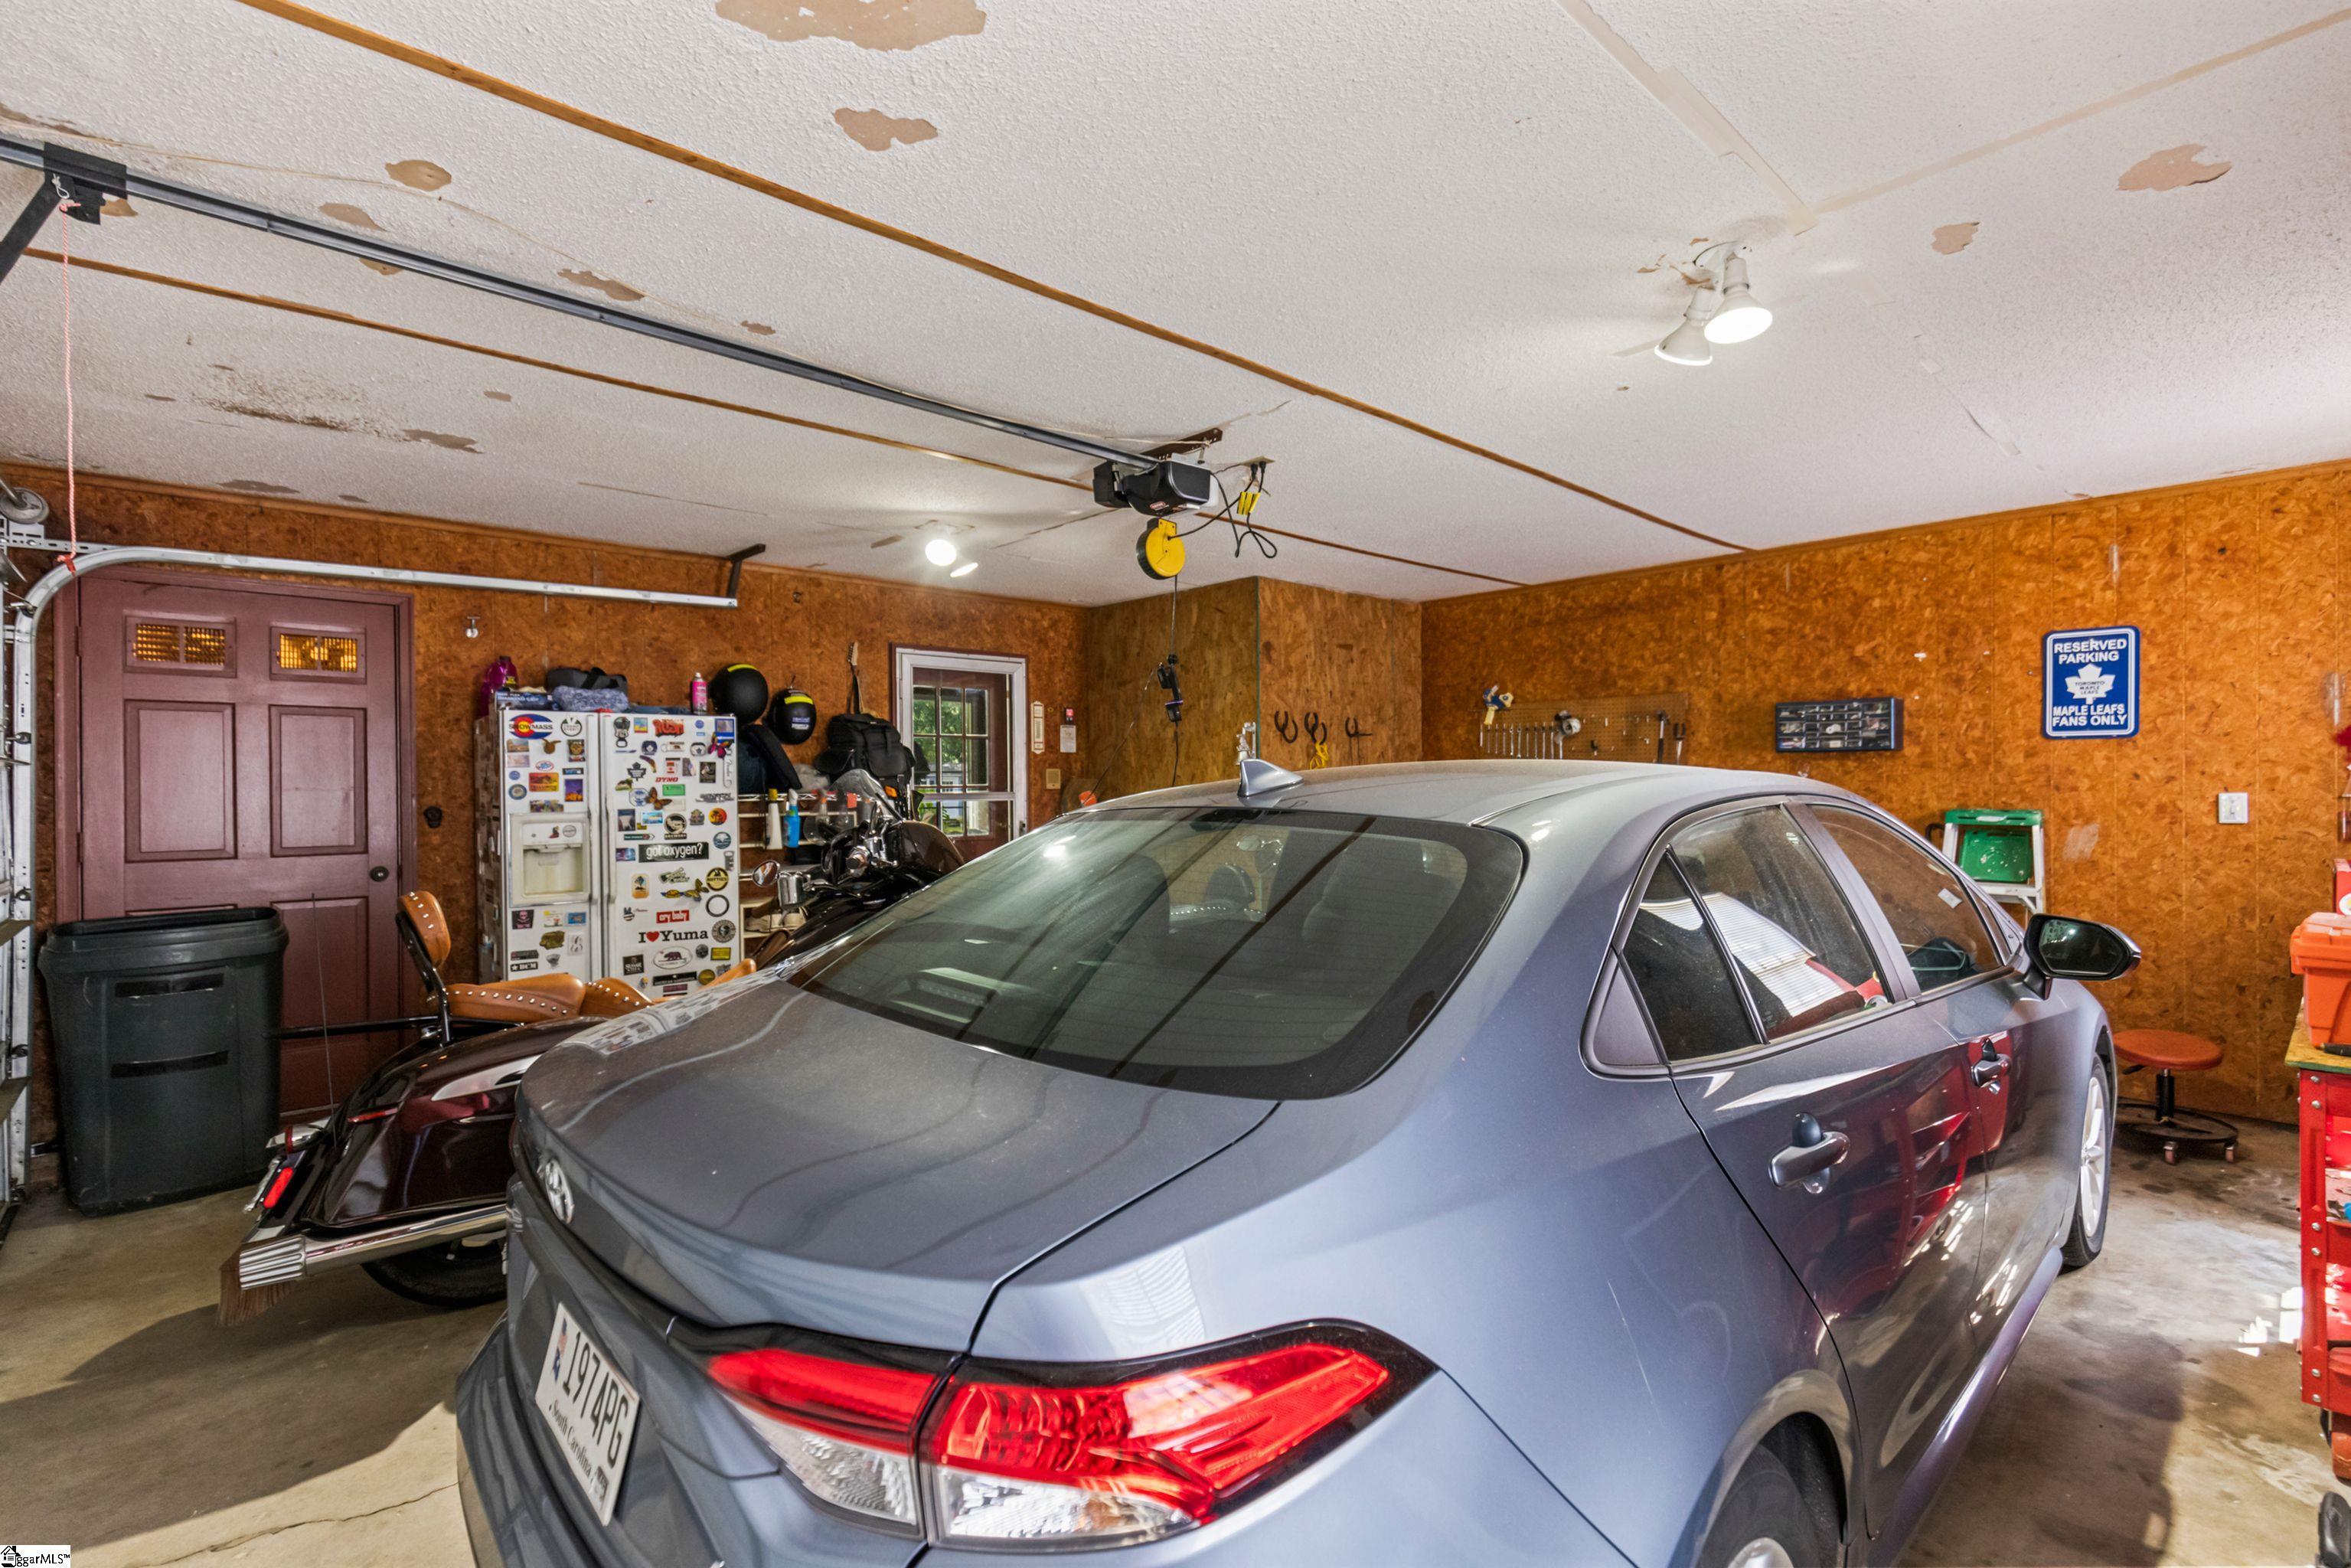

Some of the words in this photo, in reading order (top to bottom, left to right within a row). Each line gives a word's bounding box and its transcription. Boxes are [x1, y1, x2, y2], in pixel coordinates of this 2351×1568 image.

[2054, 638, 2127, 654] RESERVED
[2059, 651, 2119, 665] PARKING
[2052, 705, 2088, 717] MAPLE
[2090, 703, 2124, 715] LEAFS
[2052, 716, 2088, 727] FANS
[2090, 714, 2127, 726] ONLY
[646, 844, 661, 860] got
[663, 842, 703, 858] oxygen?
[638, 931, 646, 943] I
[660, 929, 708, 942] Yuma
[562, 1331, 629, 1469] 1974PG
[551, 1399, 568, 1433] South
[567, 1426, 592, 1477] Carolina
